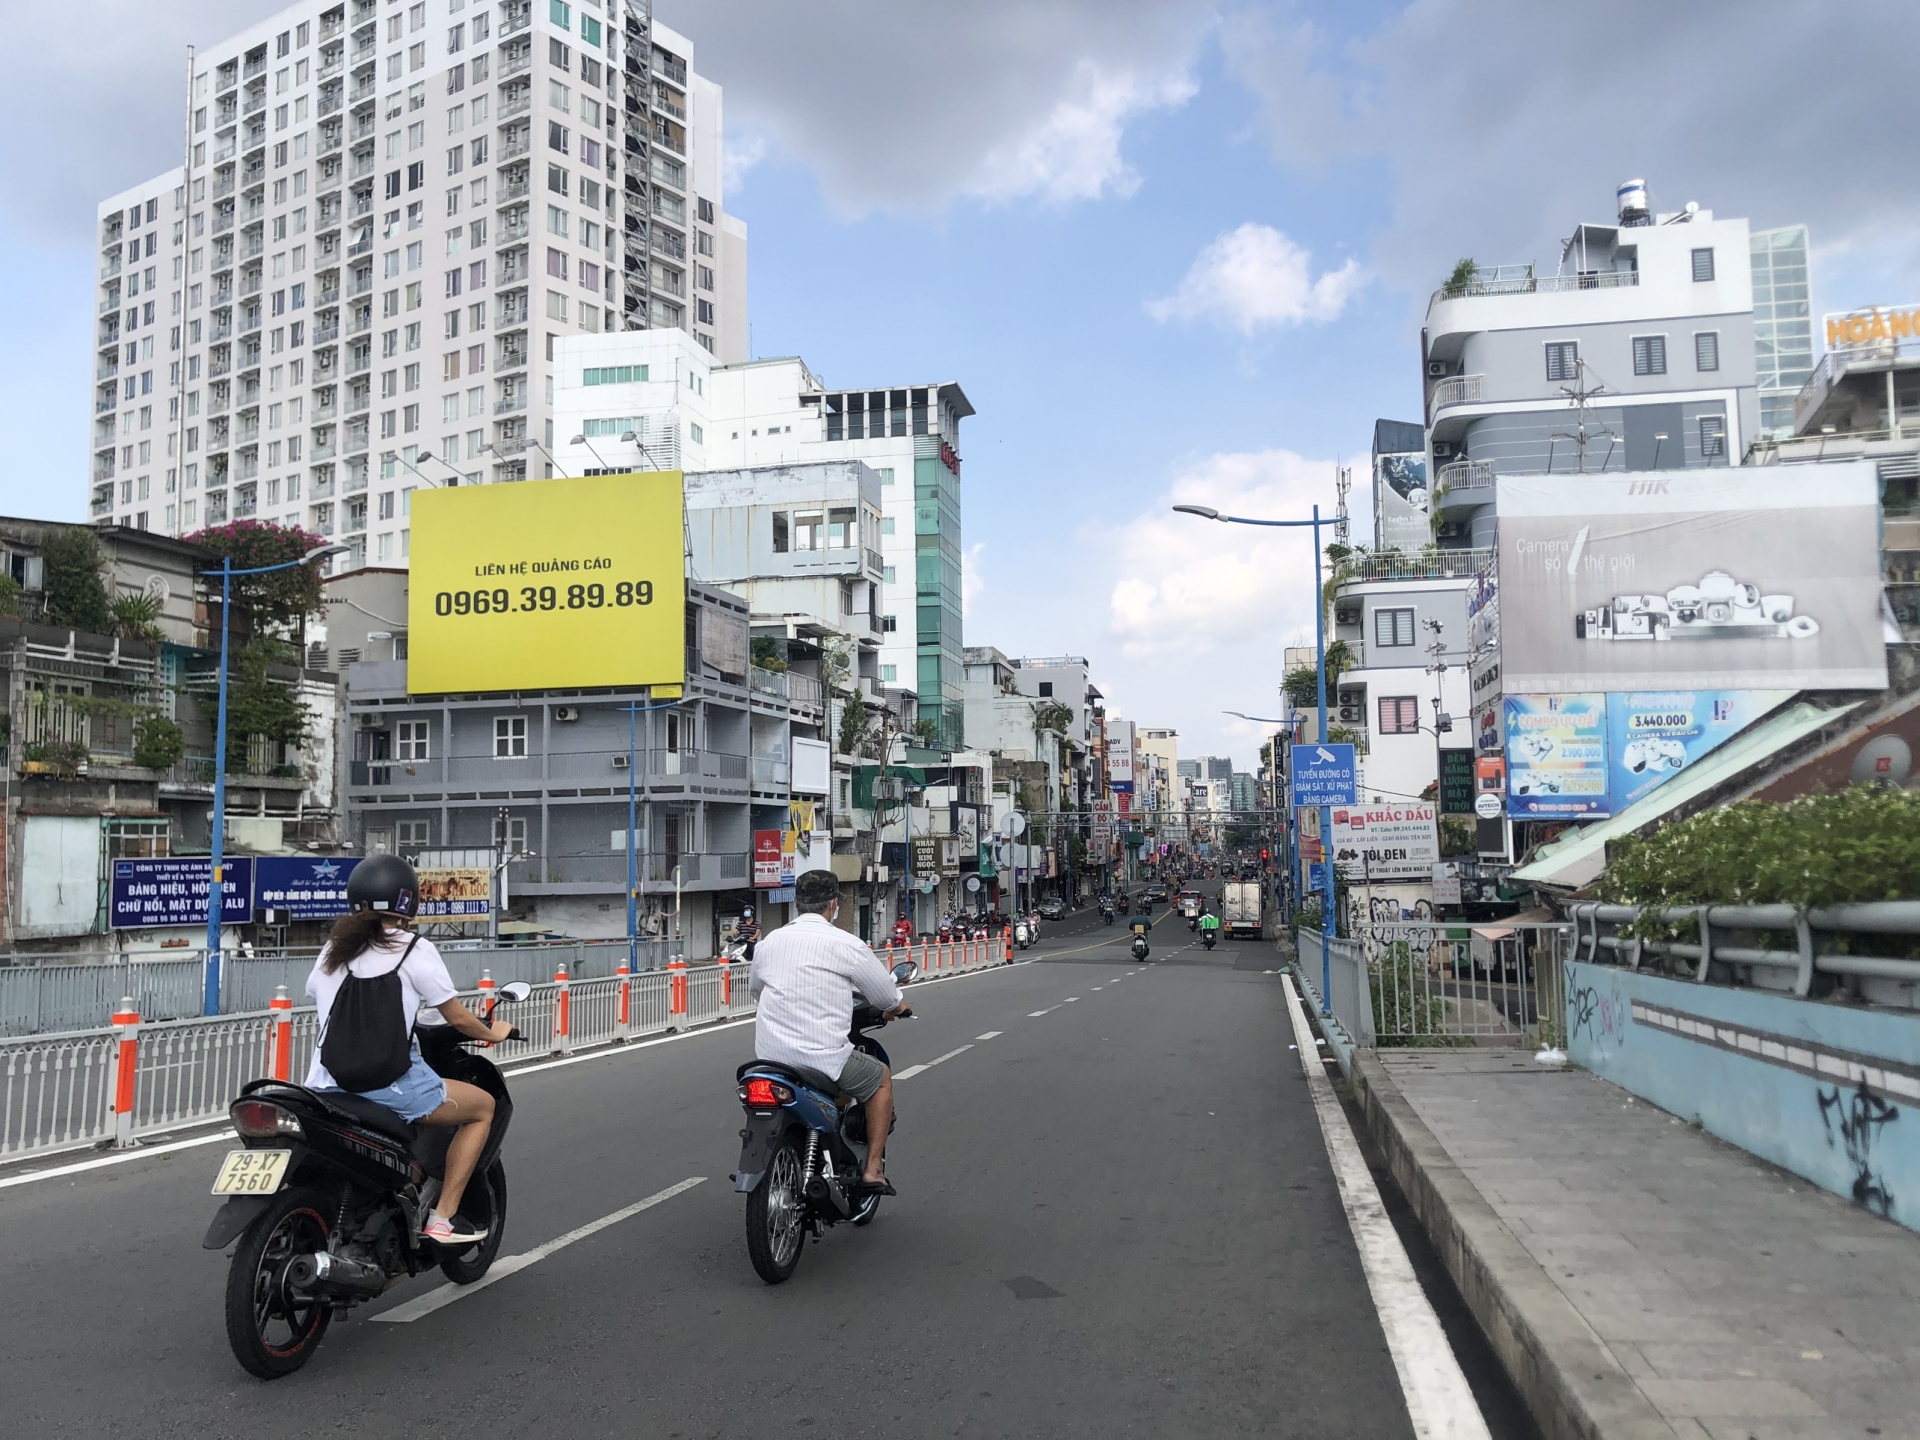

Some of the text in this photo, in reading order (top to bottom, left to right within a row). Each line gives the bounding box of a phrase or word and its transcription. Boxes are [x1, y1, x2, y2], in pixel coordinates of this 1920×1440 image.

[1516, 538, 1569, 553] Camera
[1544, 524, 1635, 575] số 1 thế giới
[475, 556, 612, 577] LIÊN HỆ QUẢNG CÁO
[435, 580, 653, 617] 0969.39.89.89
[1519, 714, 1558, 728] COMBO
[1635, 714, 1687, 727] 3.440.000
[1447, 753, 1466, 763] ĐÈN
[1561, 747, 1601, 758] 2.100.000
[1297, 767, 1350, 779] TUYẾN ĐƯỜNG CÓ
[1444, 764, 1470, 774] NĂNG
[1295, 780, 1311, 792] GIÁM
[1326, 779, 1335, 791] XỬ
[1336, 781, 1353, 793] PHẠT
[1443, 776, 1472, 786] LƯỢNG
[1303, 791, 1347, 804] BẰNG CAMERA
[1447, 787, 1468, 799] MẶT
[1448, 801, 1470, 811] TRỜI
[1365, 804, 1433, 823] KHẮC DẤU
[1384, 848, 1407, 860] ĐEN
[135, 864, 154, 872] CÔNG
[180, 864, 189, 872] QC
[783, 856, 795, 871] ĐẠT
[917, 861, 936, 870] NGỌC
[1376, 866, 1391, 874] THUẬT
[767, 867, 780, 875] ĐẠT
[128, 881, 157, 896] BẢNG
[160, 882, 188, 897] HIỆU,
[117, 899, 142, 913] CHỮ
[144, 896, 166, 913] NỔI,
[169, 898, 192, 913] MẶT
[225, 898, 245, 909] ALU
[427, 902, 435, 914] 00
[435, 901, 447, 914] 123
[451, 901, 465, 914] 0988
[466, 901, 479, 913] 1111
[480, 901, 488, 912] 79
[231, 1153, 281, 1172] 29-X7
[222, 1173, 273, 1192] 7560
